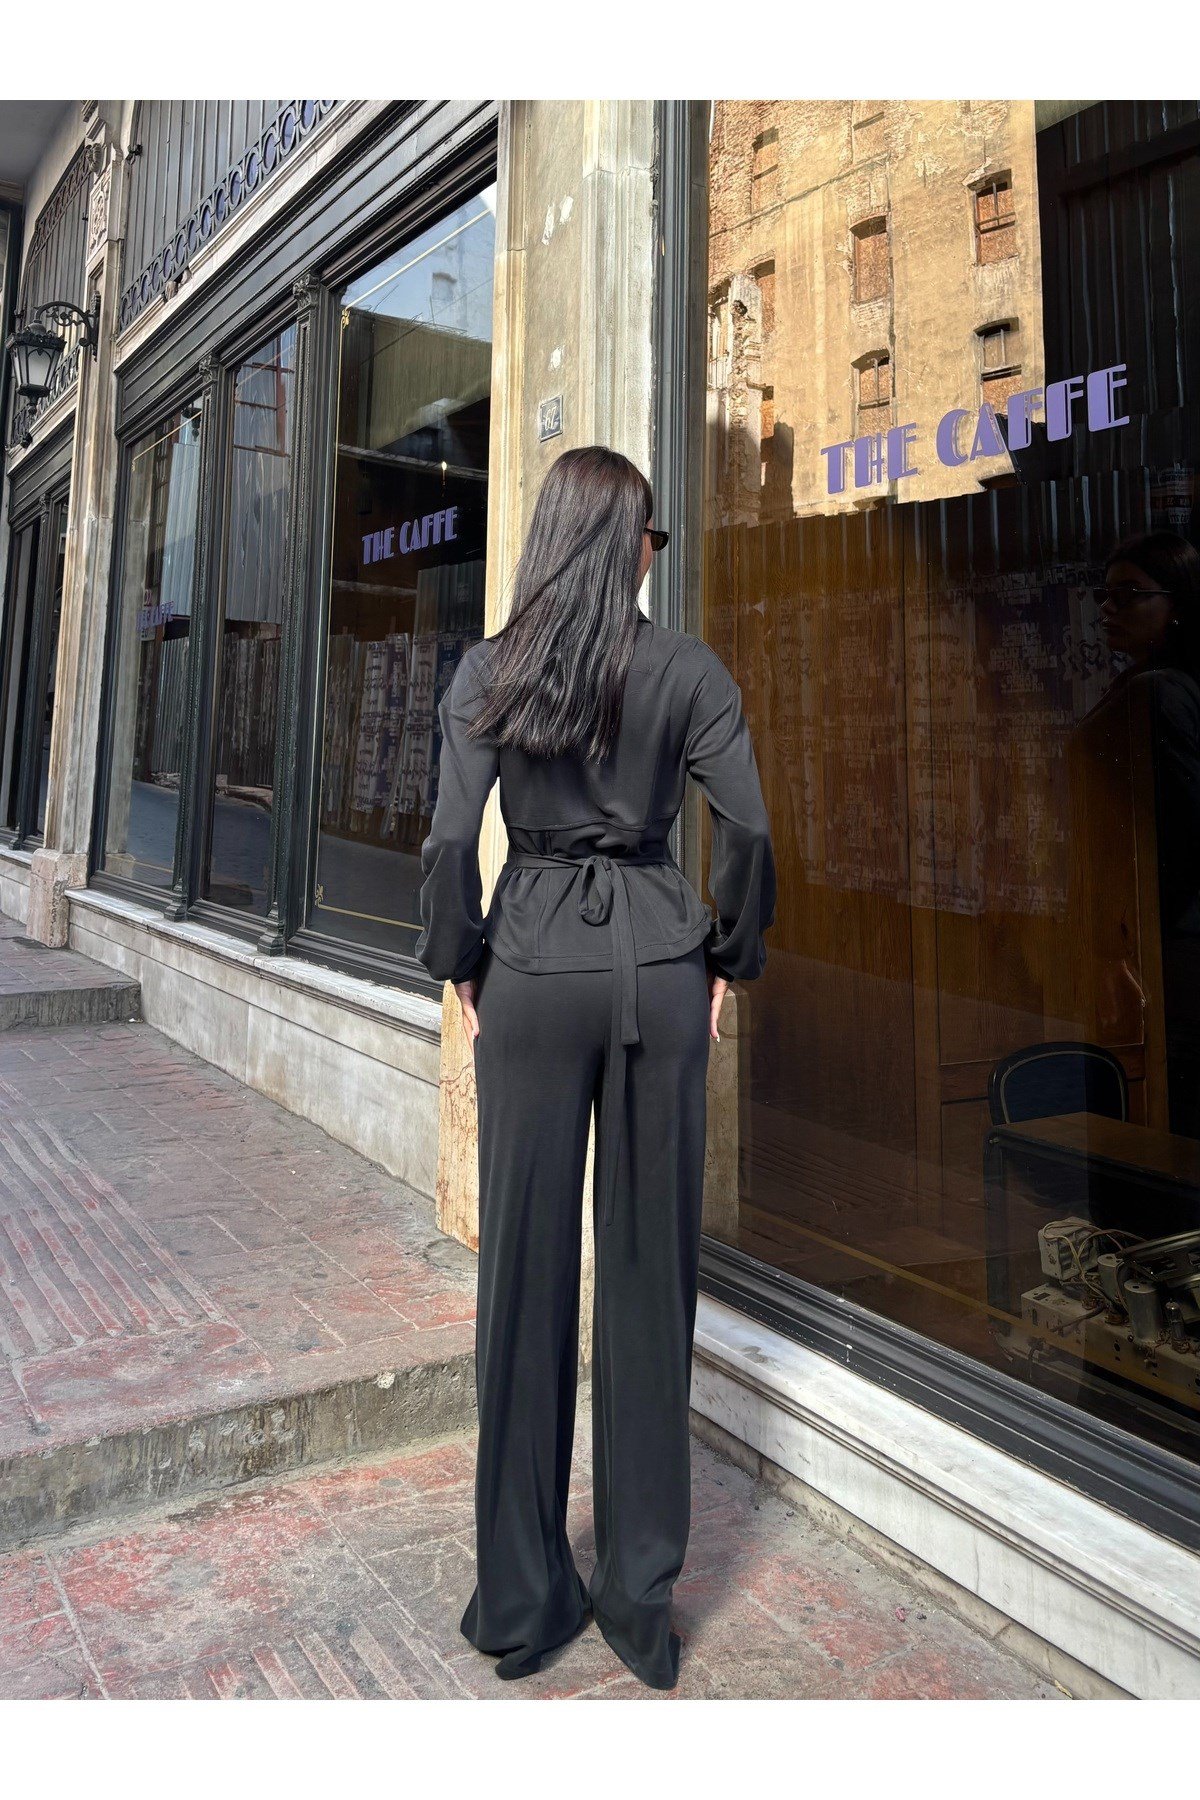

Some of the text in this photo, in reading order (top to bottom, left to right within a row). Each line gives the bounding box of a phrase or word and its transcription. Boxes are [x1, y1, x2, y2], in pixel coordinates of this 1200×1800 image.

[820, 363, 1130, 494] THE CAFFE
[362, 505, 458, 565] THE CAFFE
